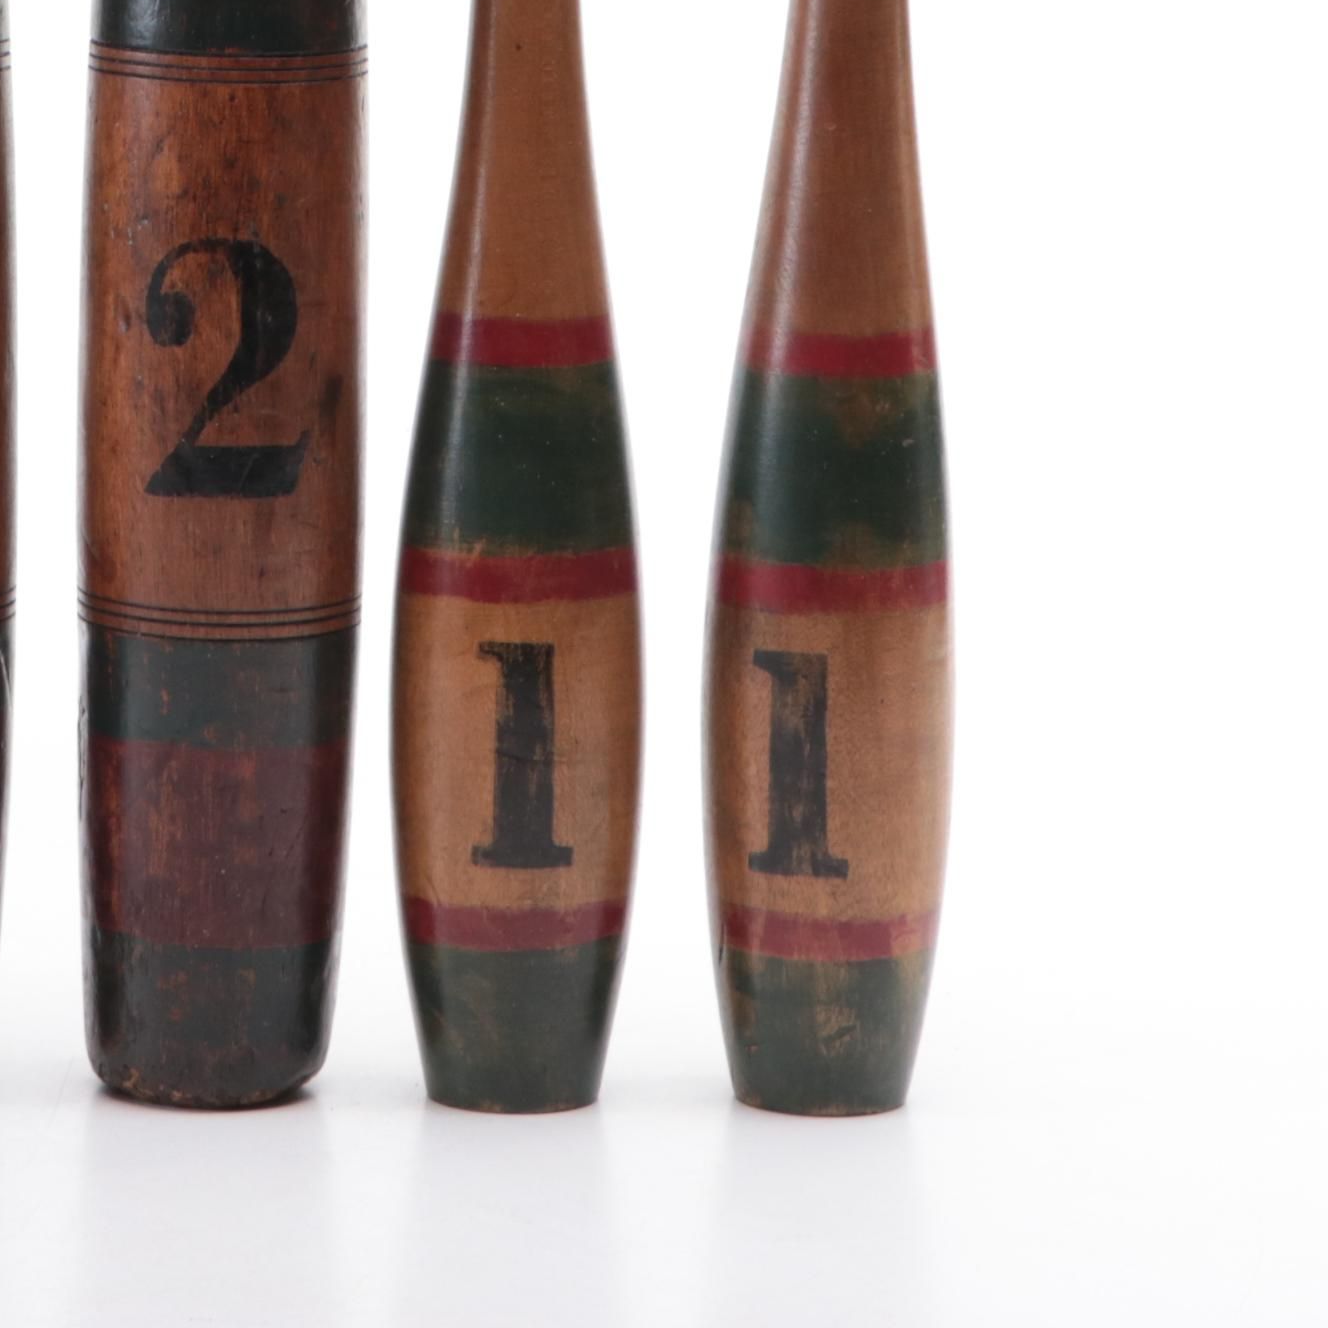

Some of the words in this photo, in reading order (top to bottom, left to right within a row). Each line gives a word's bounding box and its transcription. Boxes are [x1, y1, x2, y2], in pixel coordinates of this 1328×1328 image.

[143, 236, 312, 499] 2
[471, 641, 574, 868] 1
[748, 648, 850, 880] 1
